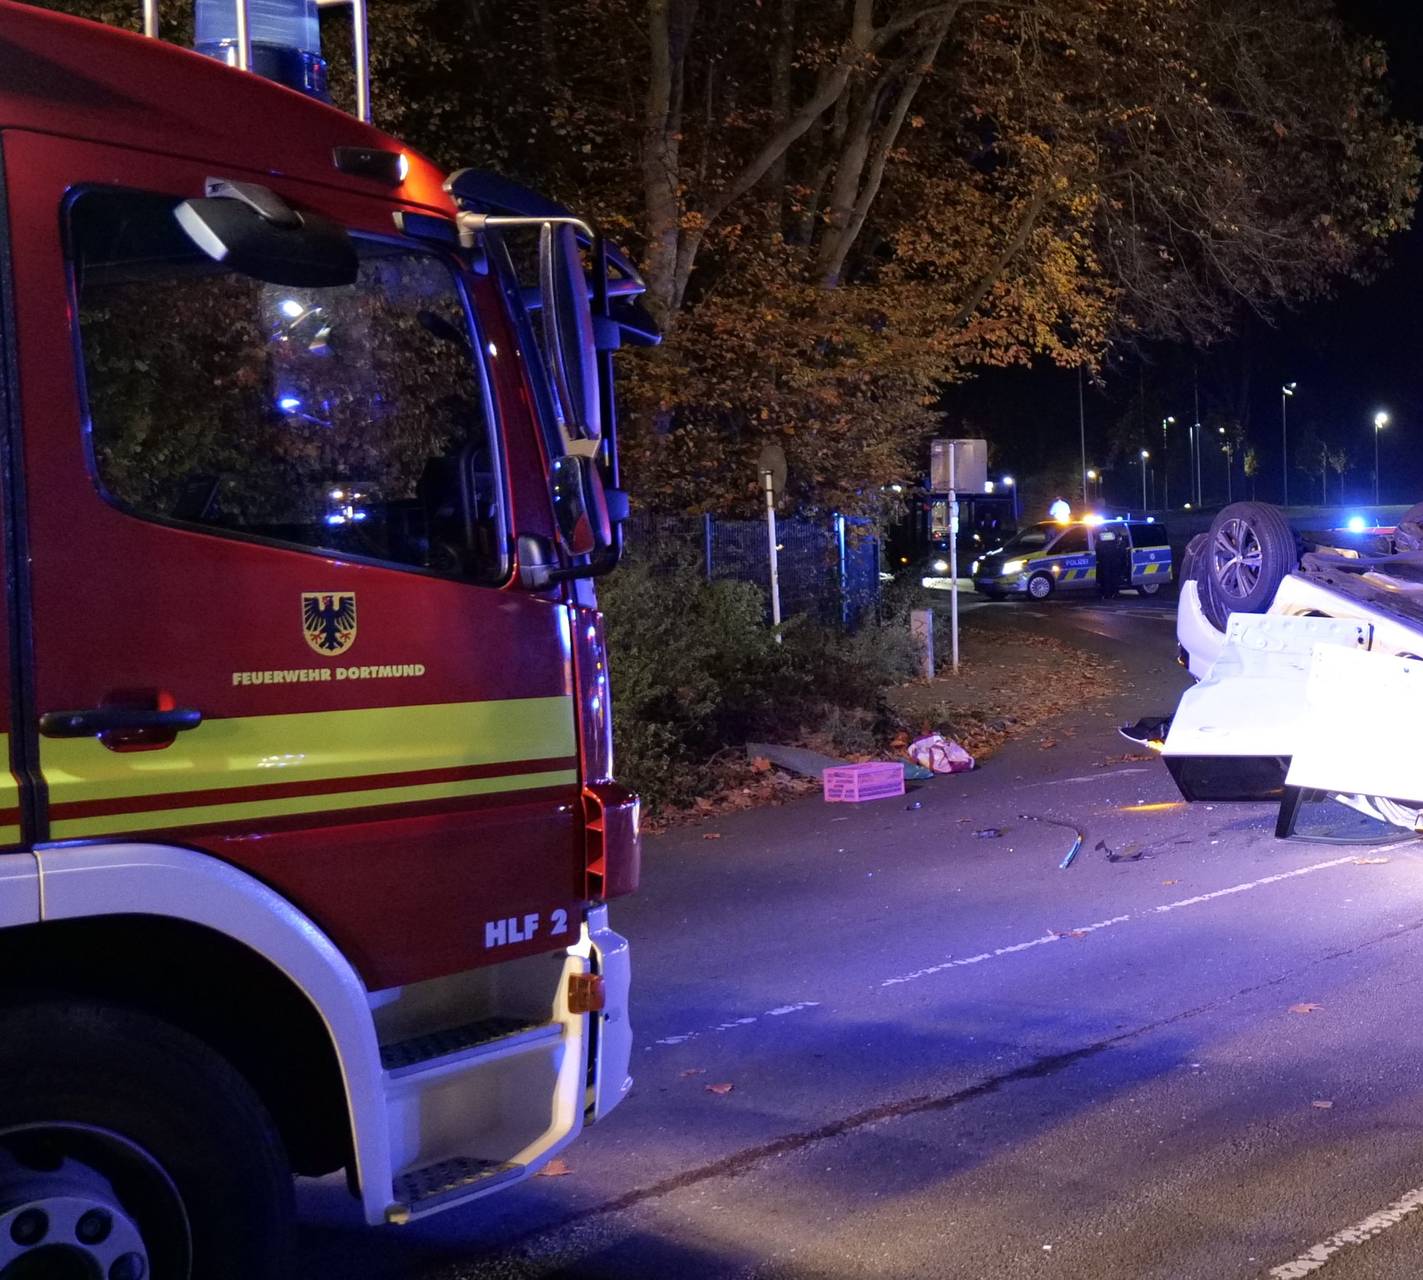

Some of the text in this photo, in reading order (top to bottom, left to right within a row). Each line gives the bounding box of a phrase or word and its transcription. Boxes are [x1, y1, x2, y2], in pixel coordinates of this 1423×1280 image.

[232, 663, 426, 686] FEUERWEHR DORTMUND
[485, 908, 569, 948] HLF 2
